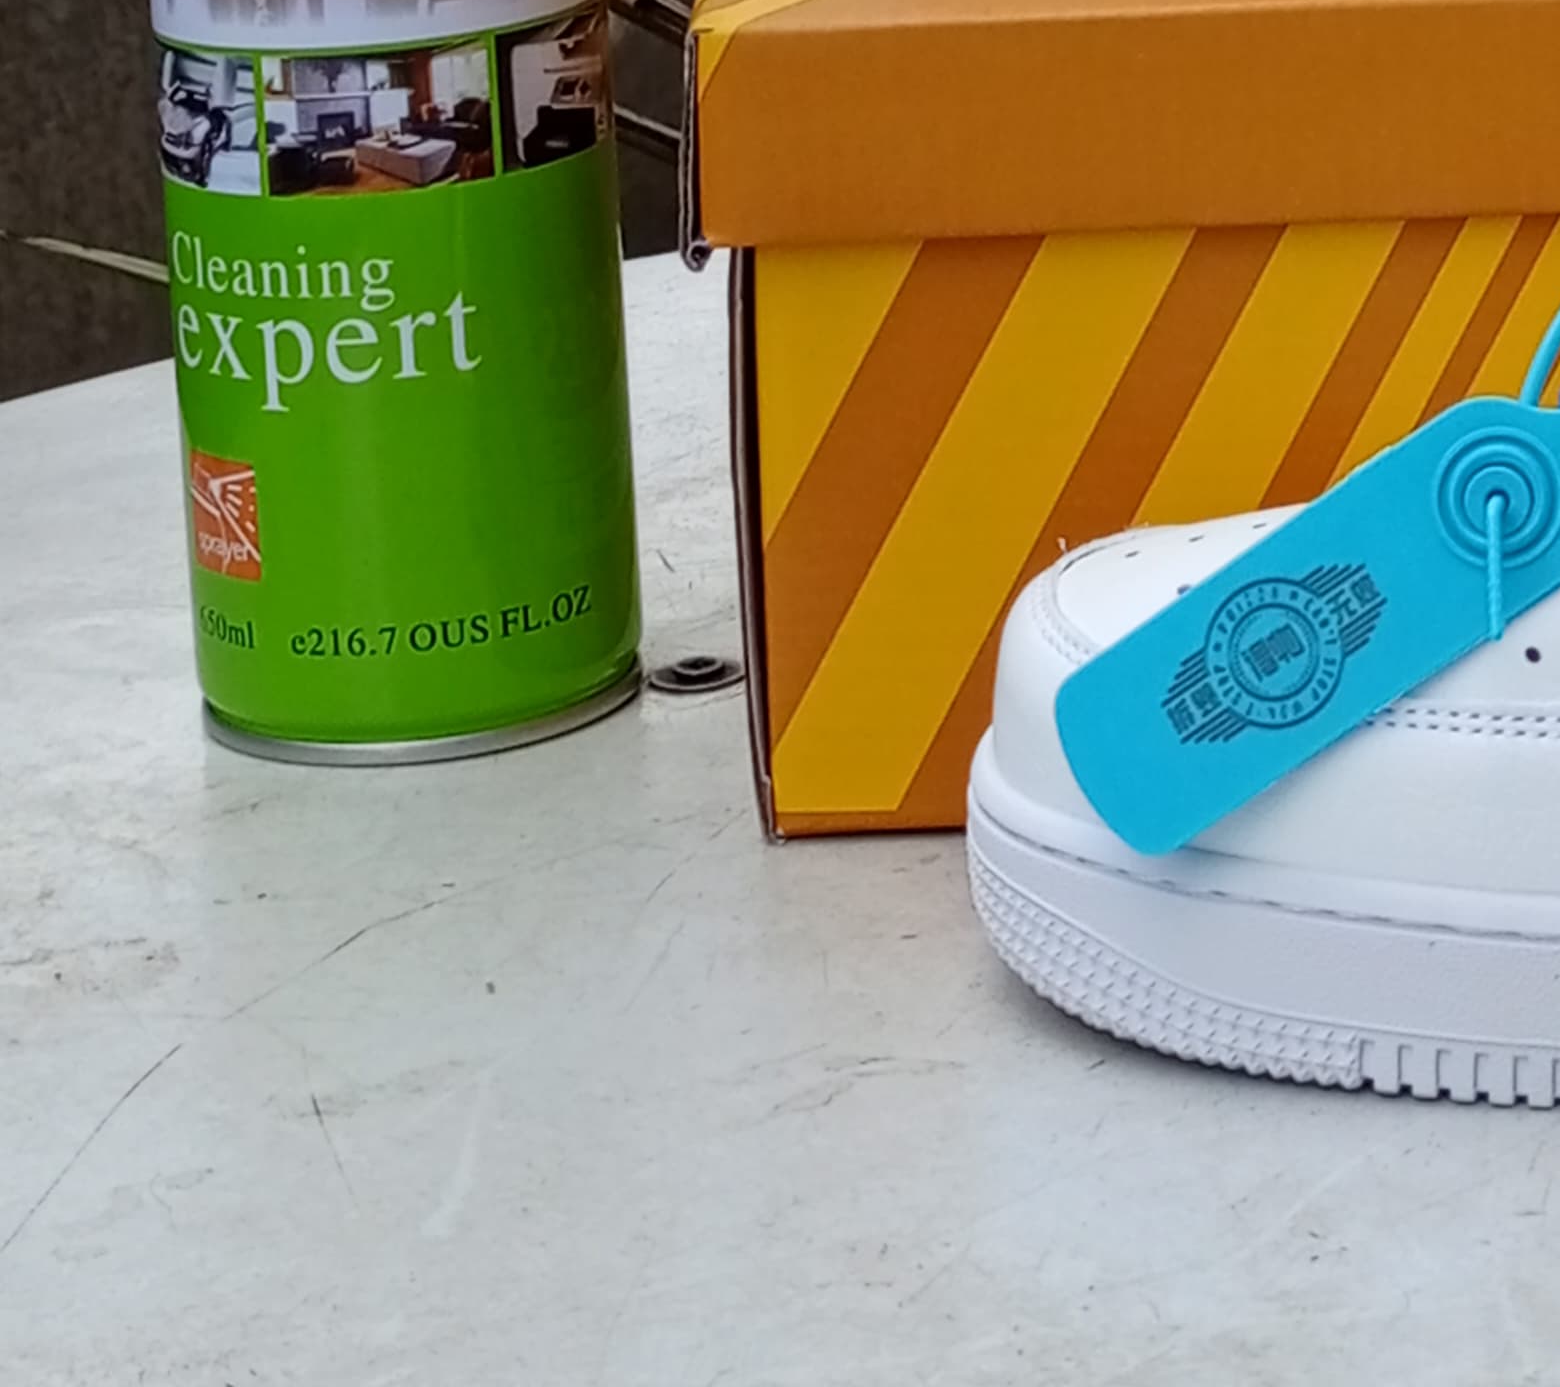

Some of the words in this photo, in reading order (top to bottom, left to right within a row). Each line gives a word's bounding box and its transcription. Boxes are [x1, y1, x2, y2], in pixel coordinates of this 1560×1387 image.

[172, 230, 395, 312] Cleaning
[178, 291, 482, 413] expert
[409, 614, 490, 653] OUS
[500, 584, 592, 638] FL.OZ
